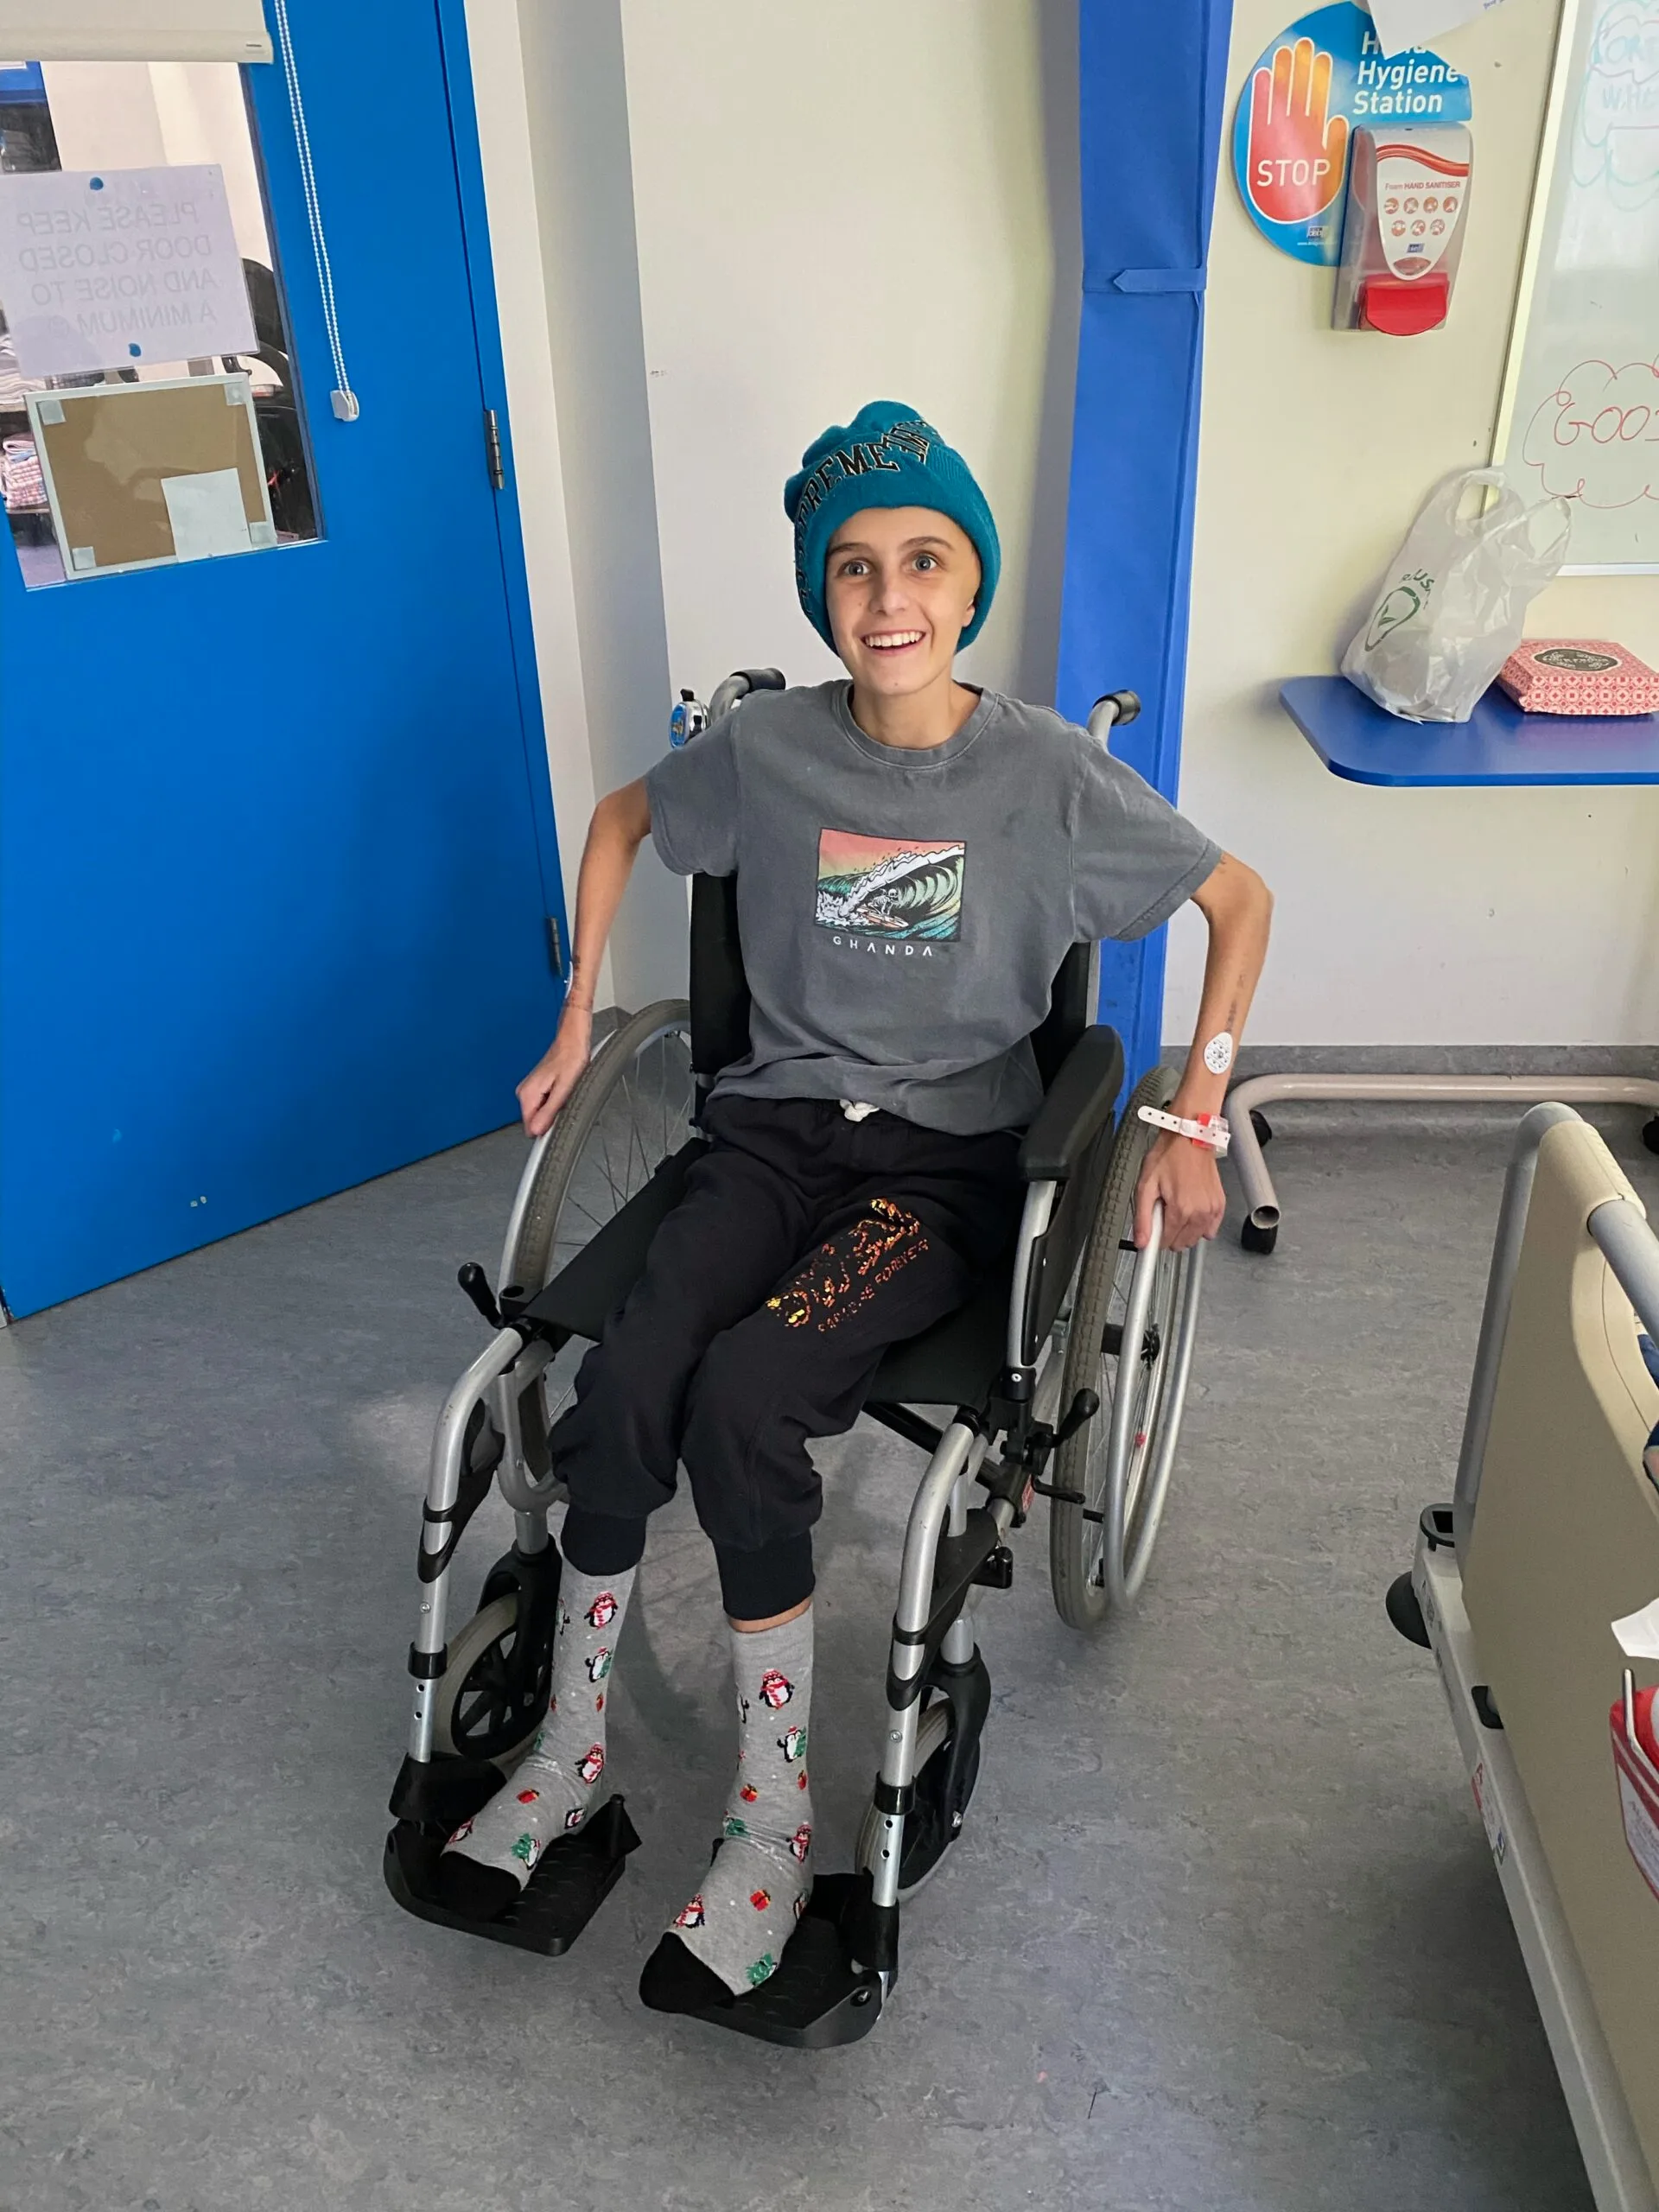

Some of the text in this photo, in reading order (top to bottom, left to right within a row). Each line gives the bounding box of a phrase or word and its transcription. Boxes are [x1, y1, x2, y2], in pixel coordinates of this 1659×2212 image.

[1357, 59, 1459, 90] Hygiene
[1352, 88, 1443, 115] Station
[1256, 159, 1331, 187] STOP
[1425, 181, 1460, 189] SANITISER
